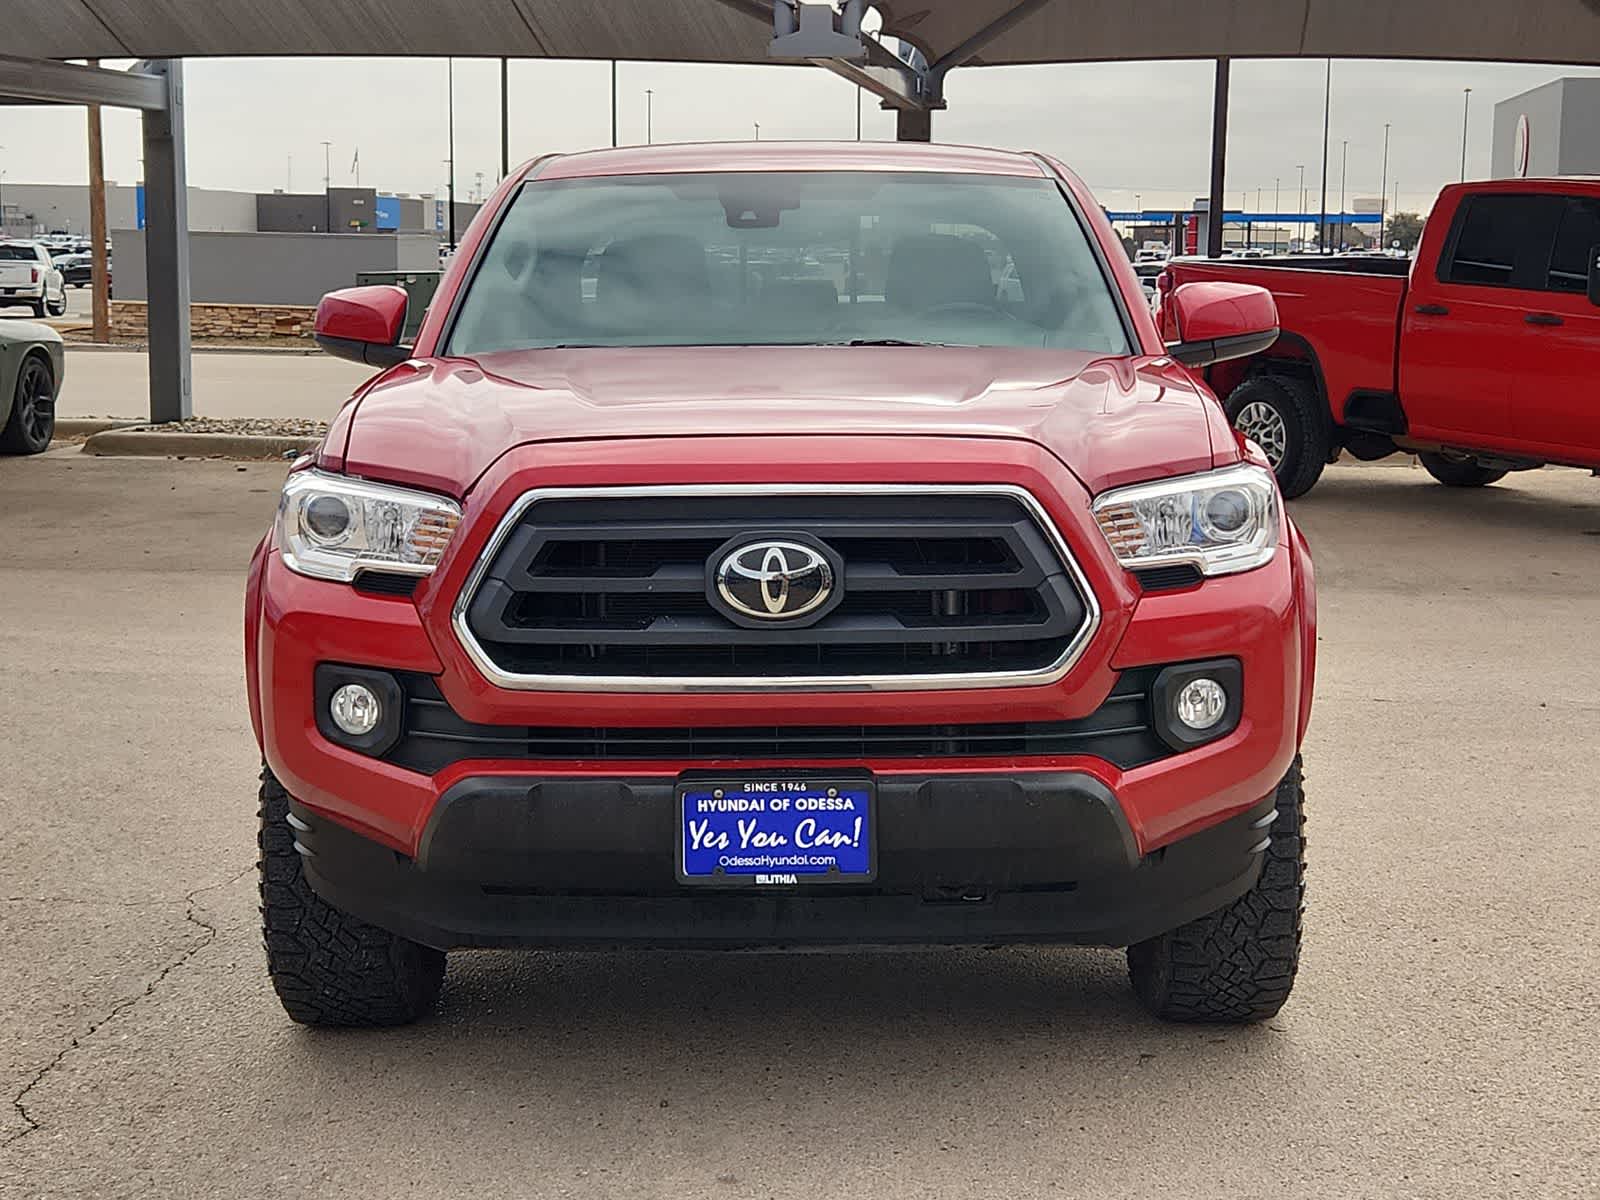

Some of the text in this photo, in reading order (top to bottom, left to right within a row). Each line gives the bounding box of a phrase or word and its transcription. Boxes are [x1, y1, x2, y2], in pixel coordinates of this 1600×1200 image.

[744, 783, 807, 793] SINCE 1946
[697, 798, 854, 812] HYUNDAI OF ODESSA
[689, 816, 863, 850] Yes You Can!
[719, 855, 836, 867] OdessaHyundai.com
